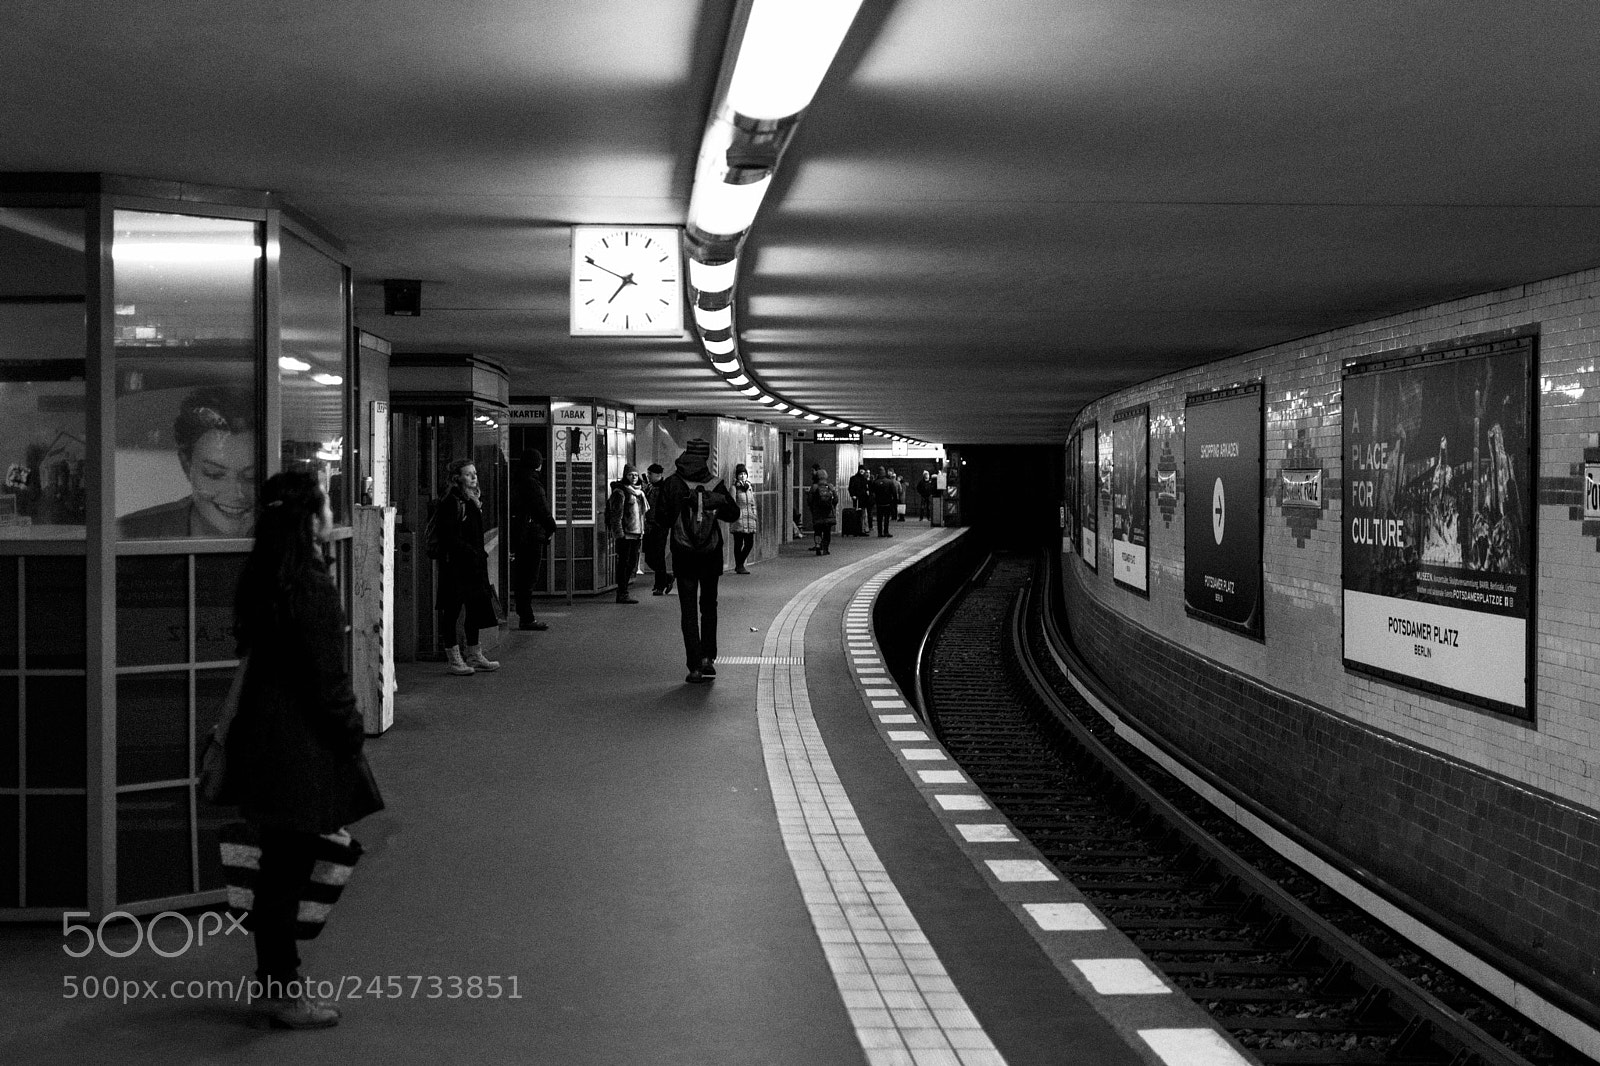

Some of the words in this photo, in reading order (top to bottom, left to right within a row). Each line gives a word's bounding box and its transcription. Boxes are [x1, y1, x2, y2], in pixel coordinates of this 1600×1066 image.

[560, 409, 585, 419] TABAK
[1351, 408, 1361, 434] A
[556, 430, 592, 441] CY
[1351, 441, 1389, 472] PLACE
[1351, 480, 1374, 507] FOR
[1586, 472, 1600, 512] PO
[1351, 518, 1405, 548] CULTURE
[1223, 579, 1235, 594] PLATZ
[1388, 615, 1432, 642] POTSDAMER
[1433, 627, 1459, 648] PLATZ
[1414, 643, 1432, 659] BERLIN
